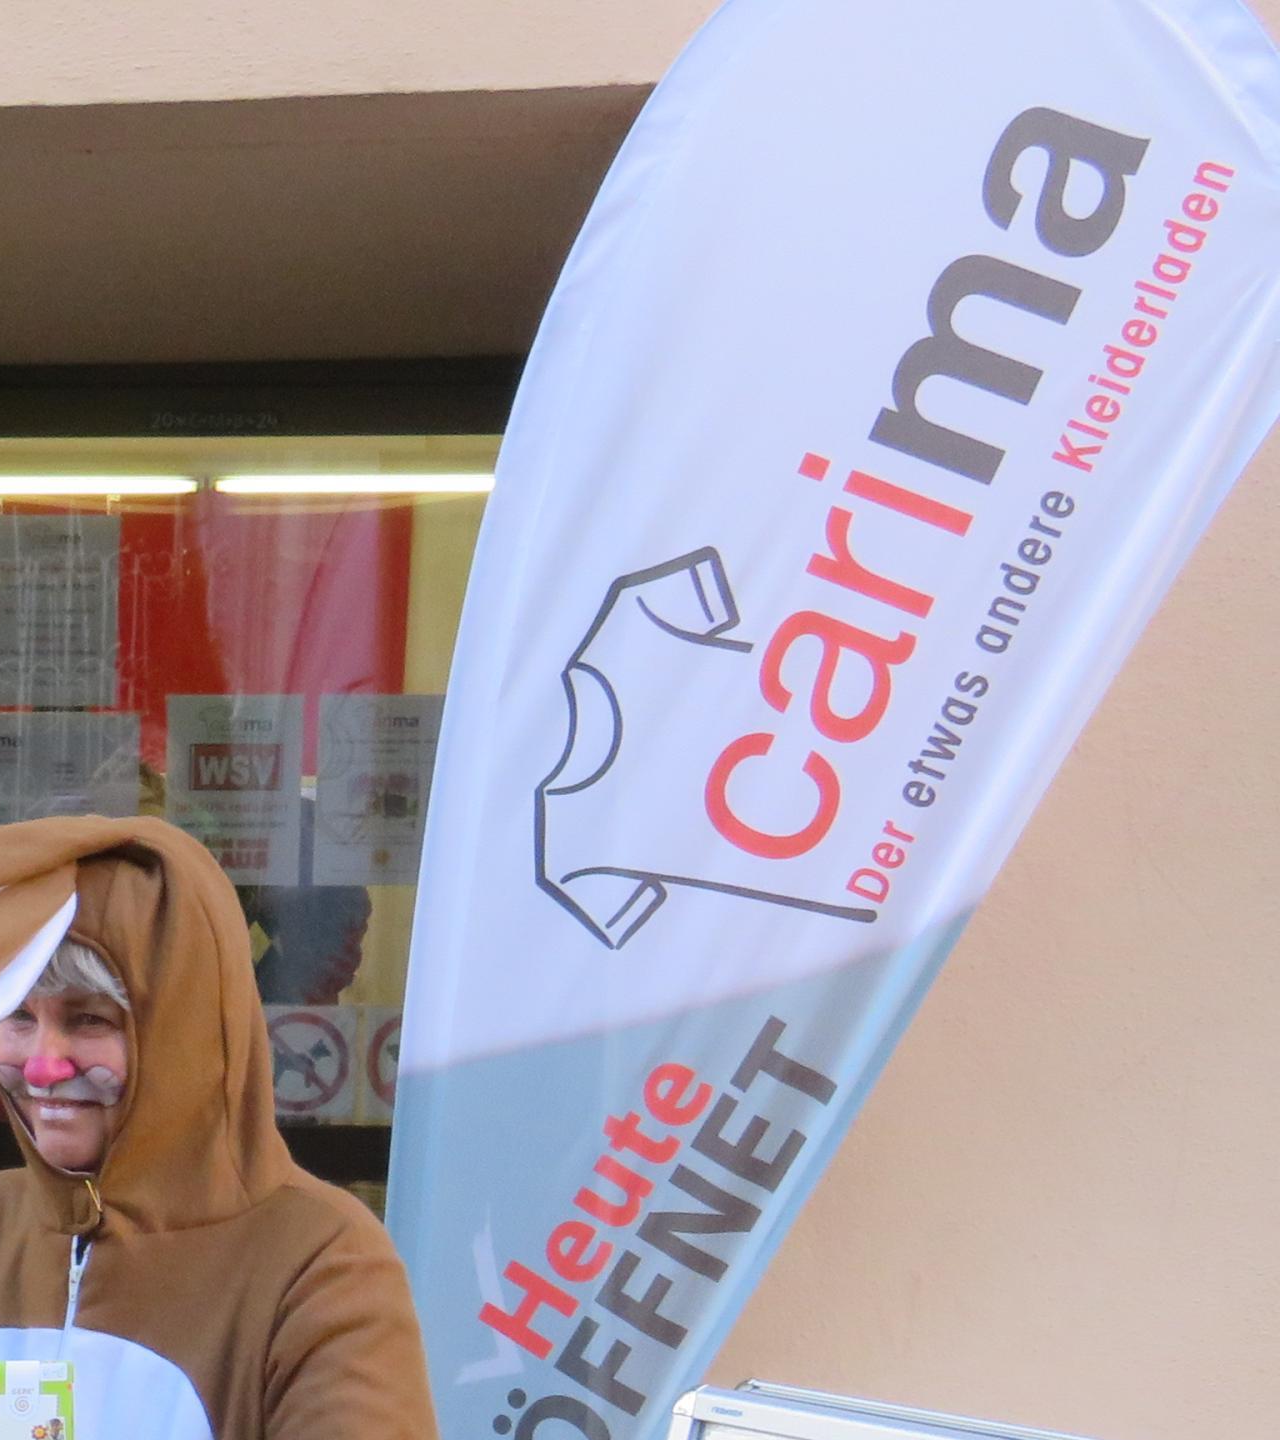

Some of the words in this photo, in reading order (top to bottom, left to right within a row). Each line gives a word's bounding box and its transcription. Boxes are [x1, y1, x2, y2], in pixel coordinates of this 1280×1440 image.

[704, 106, 1151, 859] carima
[846, 820, 915, 905] Der
[902, 670, 989, 809] etwas
[974, 489, 1074, 654] andere
[1051, 159, 1236, 473] Kleiderladen
[198, 754, 276, 786] WSV
[478, 1063, 713, 1360] Heute
